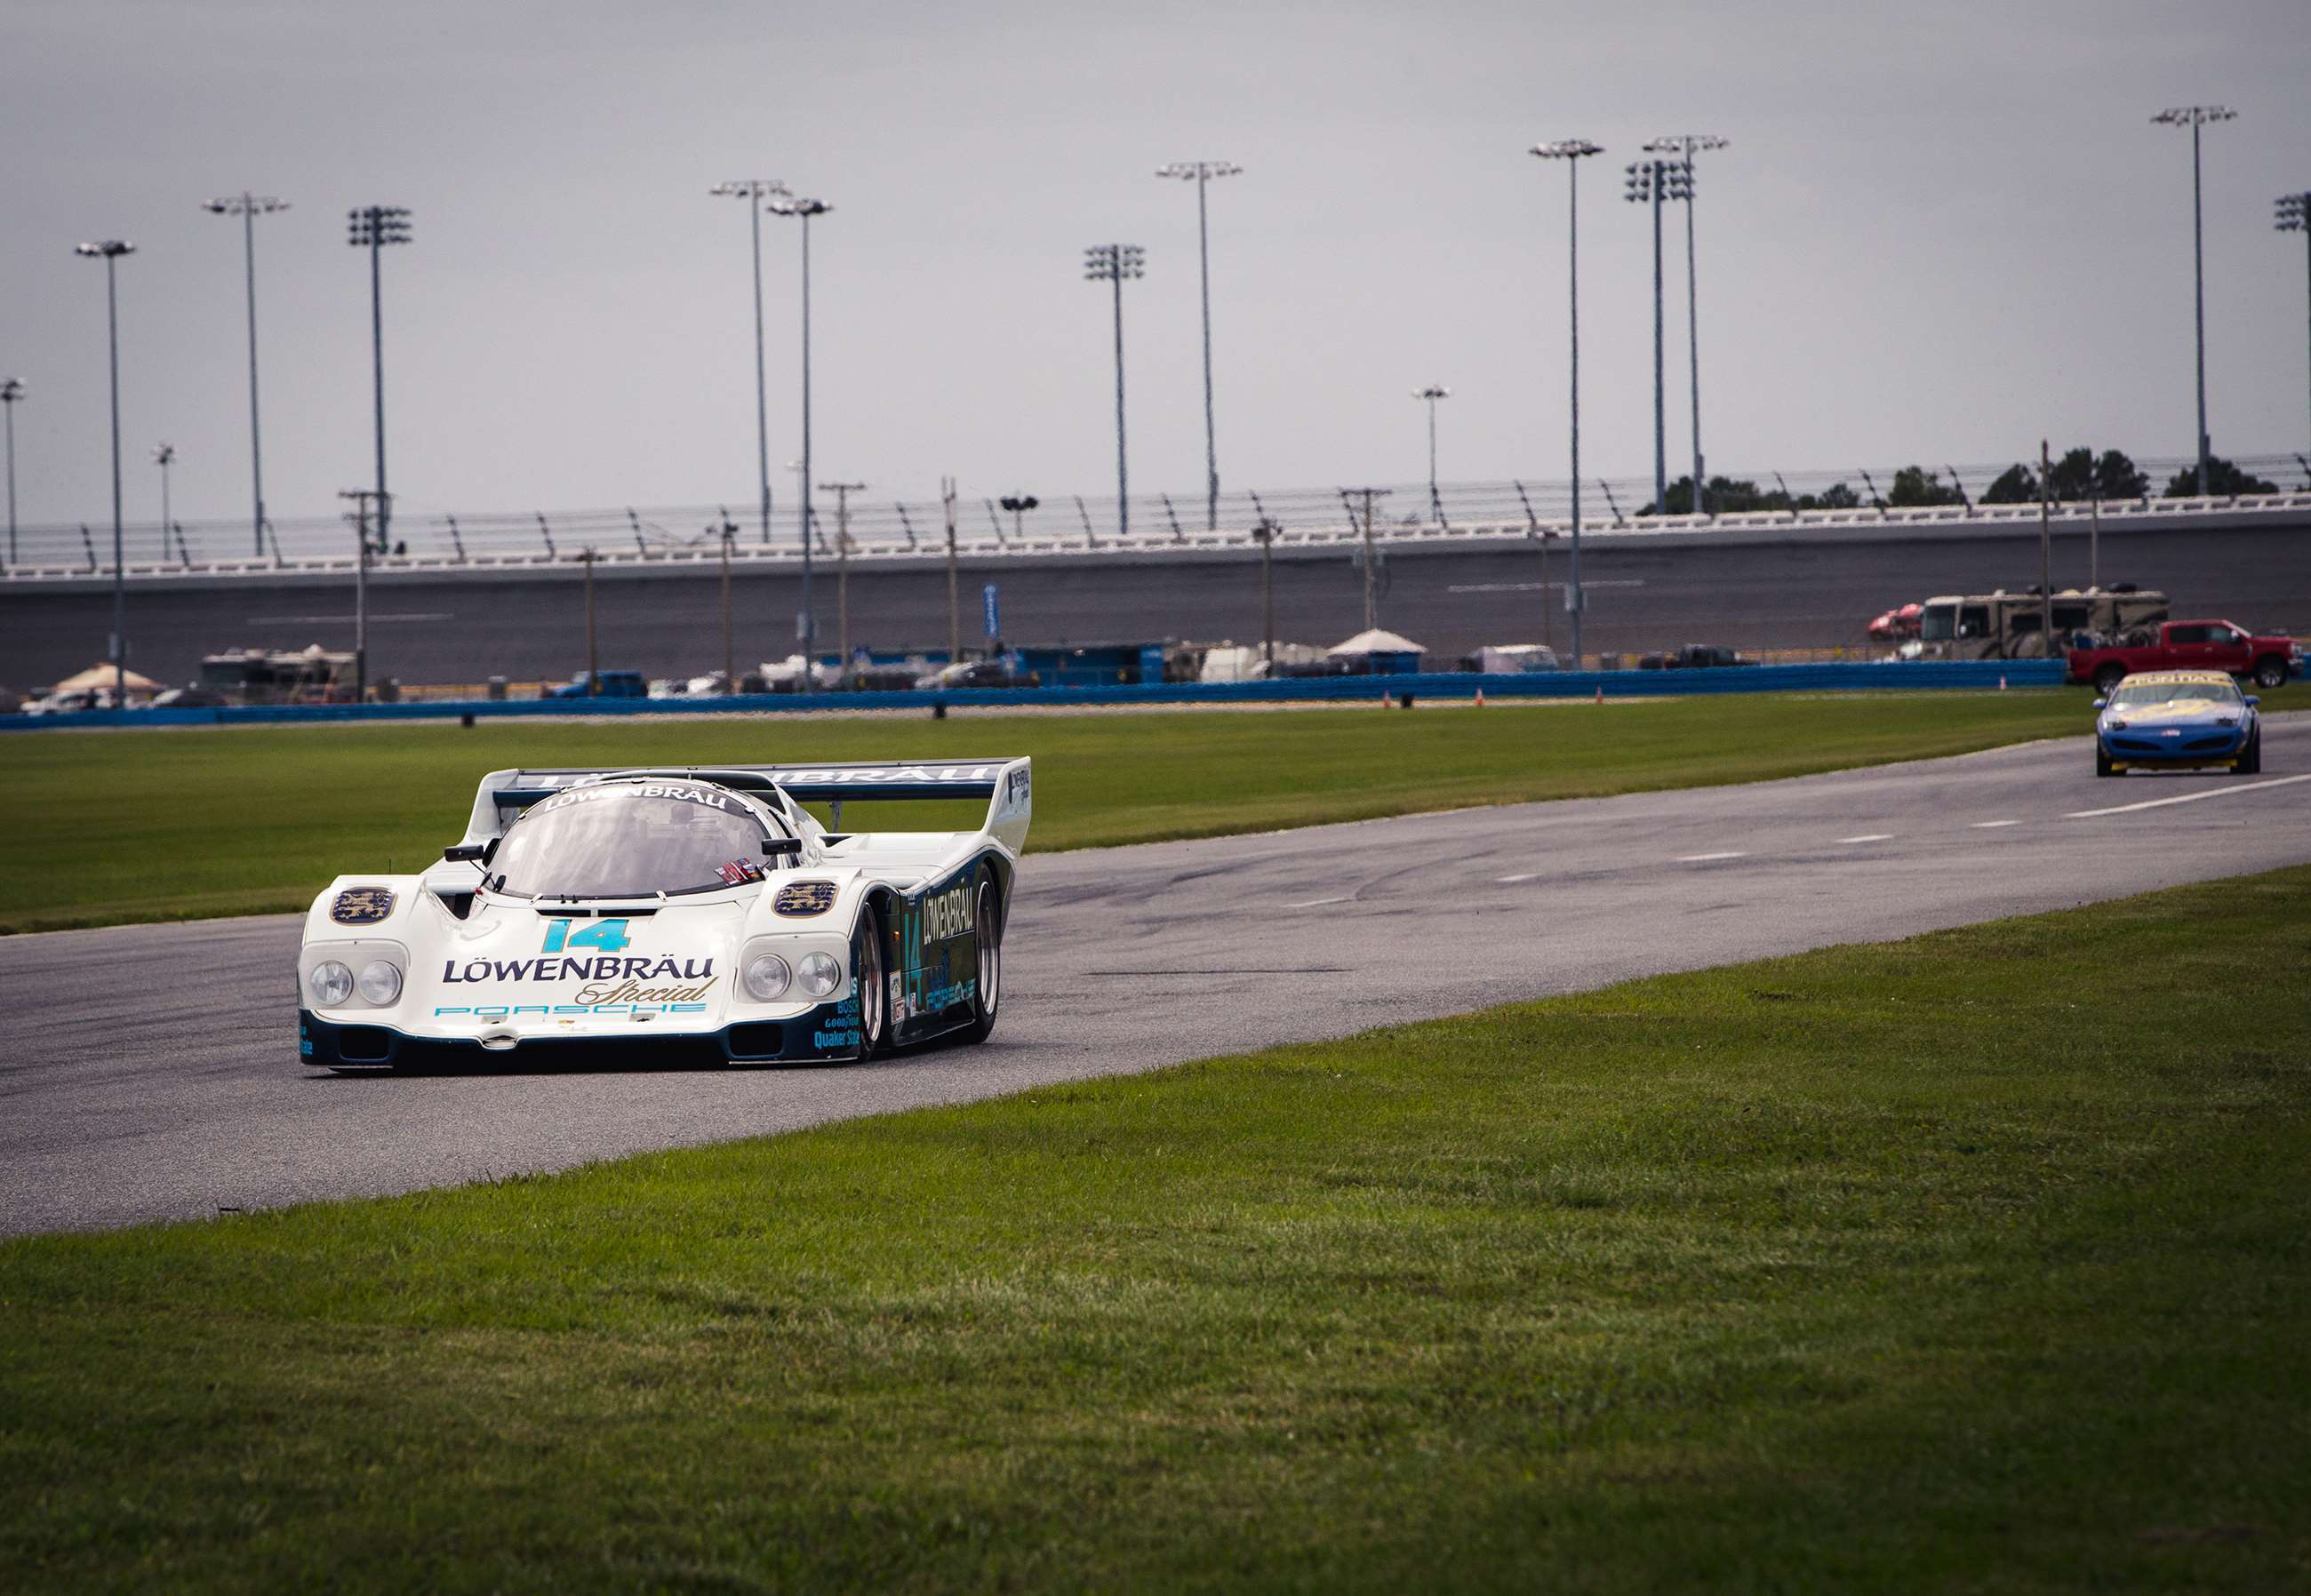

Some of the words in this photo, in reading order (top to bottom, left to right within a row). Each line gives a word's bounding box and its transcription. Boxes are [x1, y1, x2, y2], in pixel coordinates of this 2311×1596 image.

[540, 918, 632, 954] 14
[443, 954, 715, 983] LÖWENBRÄU
[574, 977, 719, 1005] Special
[435, 1003, 708, 1017] PORSCHE
[814, 1031, 845, 1049] Quaker
